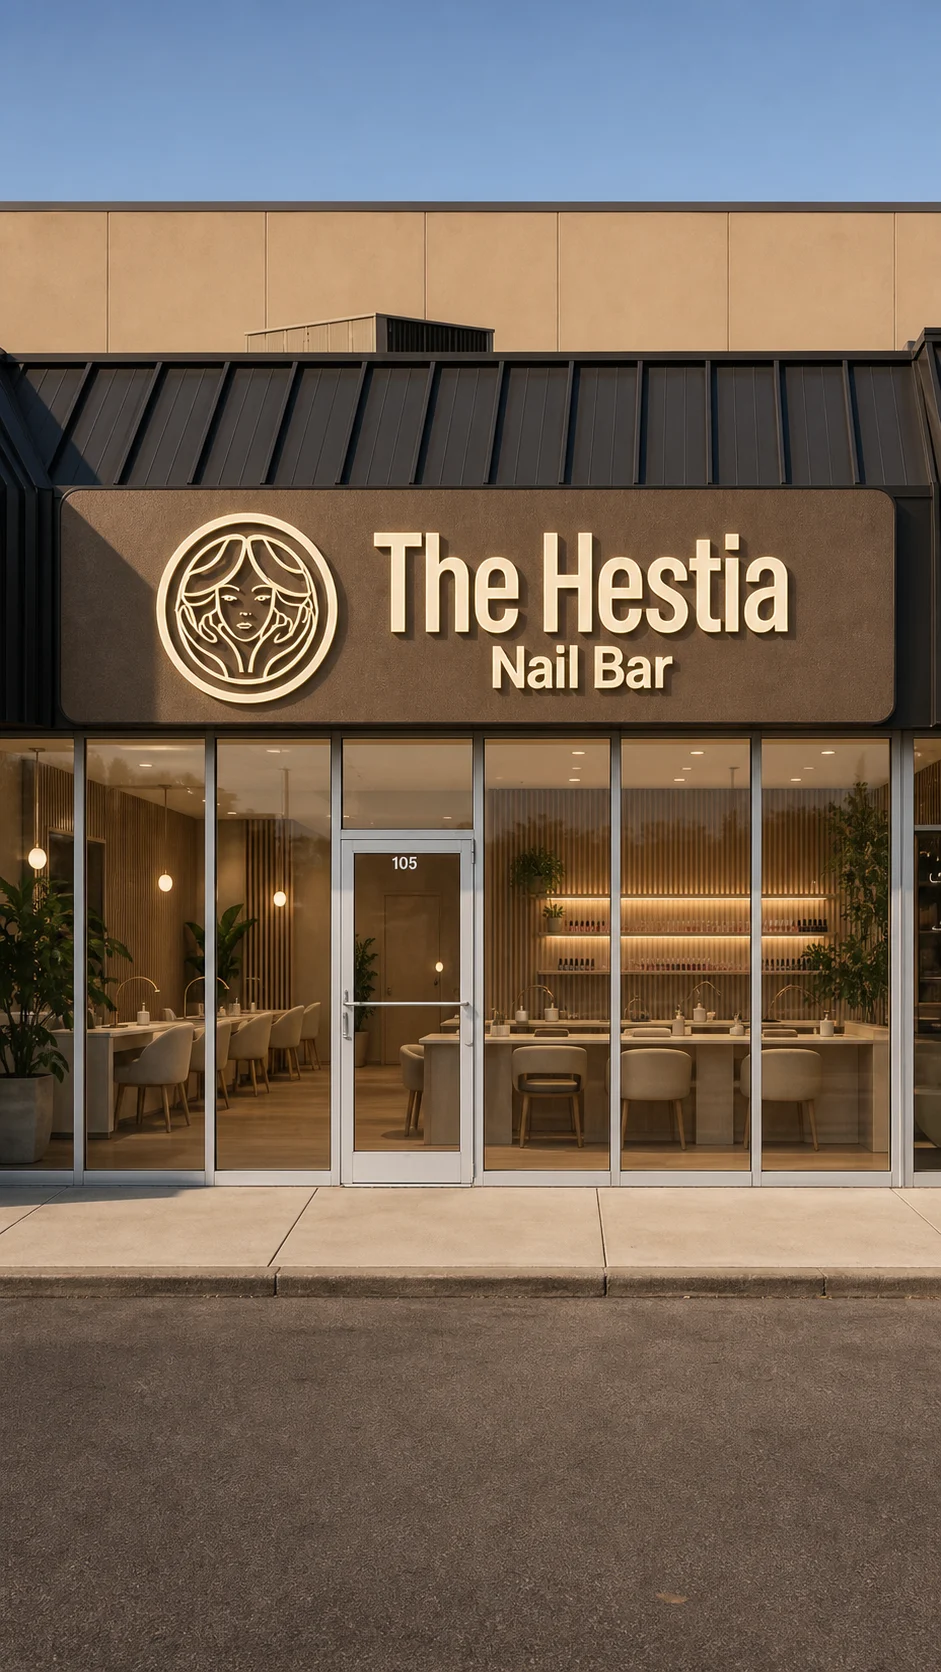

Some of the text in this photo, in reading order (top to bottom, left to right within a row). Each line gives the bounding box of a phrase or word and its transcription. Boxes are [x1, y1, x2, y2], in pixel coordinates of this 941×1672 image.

[373, 532, 790, 634] The Hestia
[492, 645, 673, 690] Nail Bar
[391, 856, 418, 870] 105
